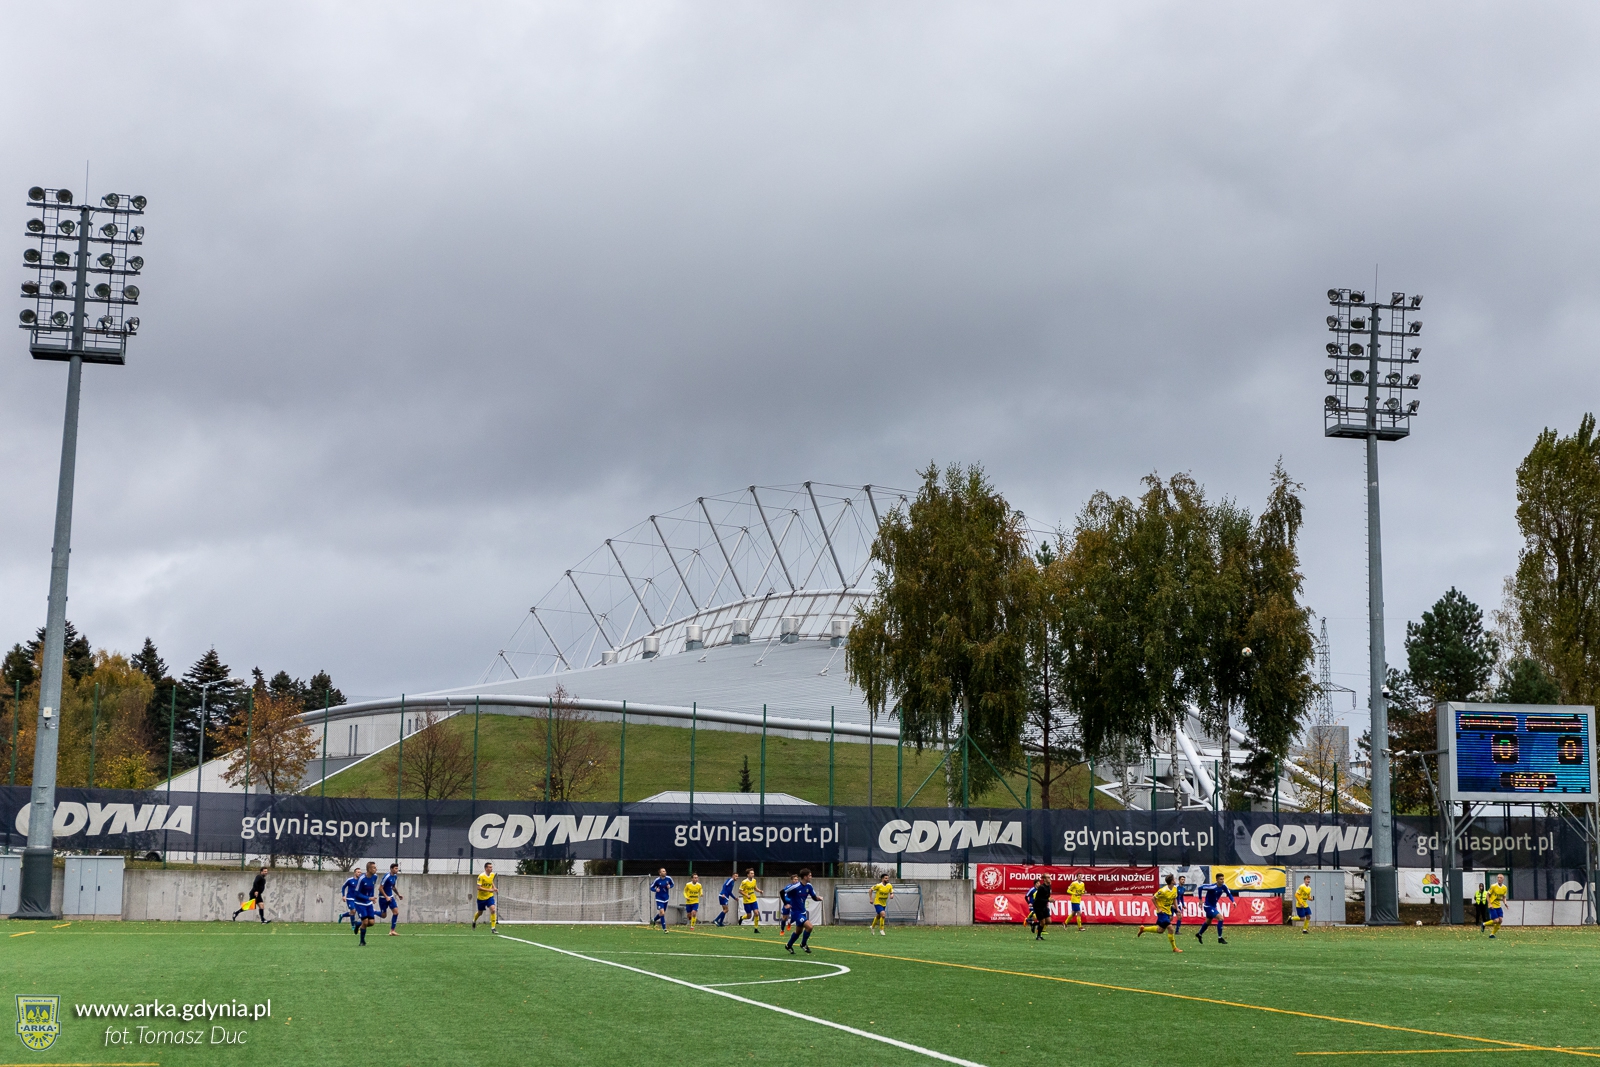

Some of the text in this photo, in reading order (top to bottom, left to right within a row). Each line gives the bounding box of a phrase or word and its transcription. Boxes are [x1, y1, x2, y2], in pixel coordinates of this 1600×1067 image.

[240, 811, 420, 844] gdyniasport.pl
[468, 813, 630, 849] GDYNIA
[674, 820, 840, 849] gdyniasport.pl
[878, 819, 1022, 854] GDYNIA
[1063, 825, 1214, 853] gdyniasport.pl
[1250, 823, 1373, 856] GDYNI
[1416, 831, 1554, 856] gdniasport.pl
[1098, 874, 1120, 882] PIŁKI
[1121, 872, 1155, 882] NOŻNEJ
[1422, 885, 1445, 897] op
[1119, 901, 1151, 917] LIGA
